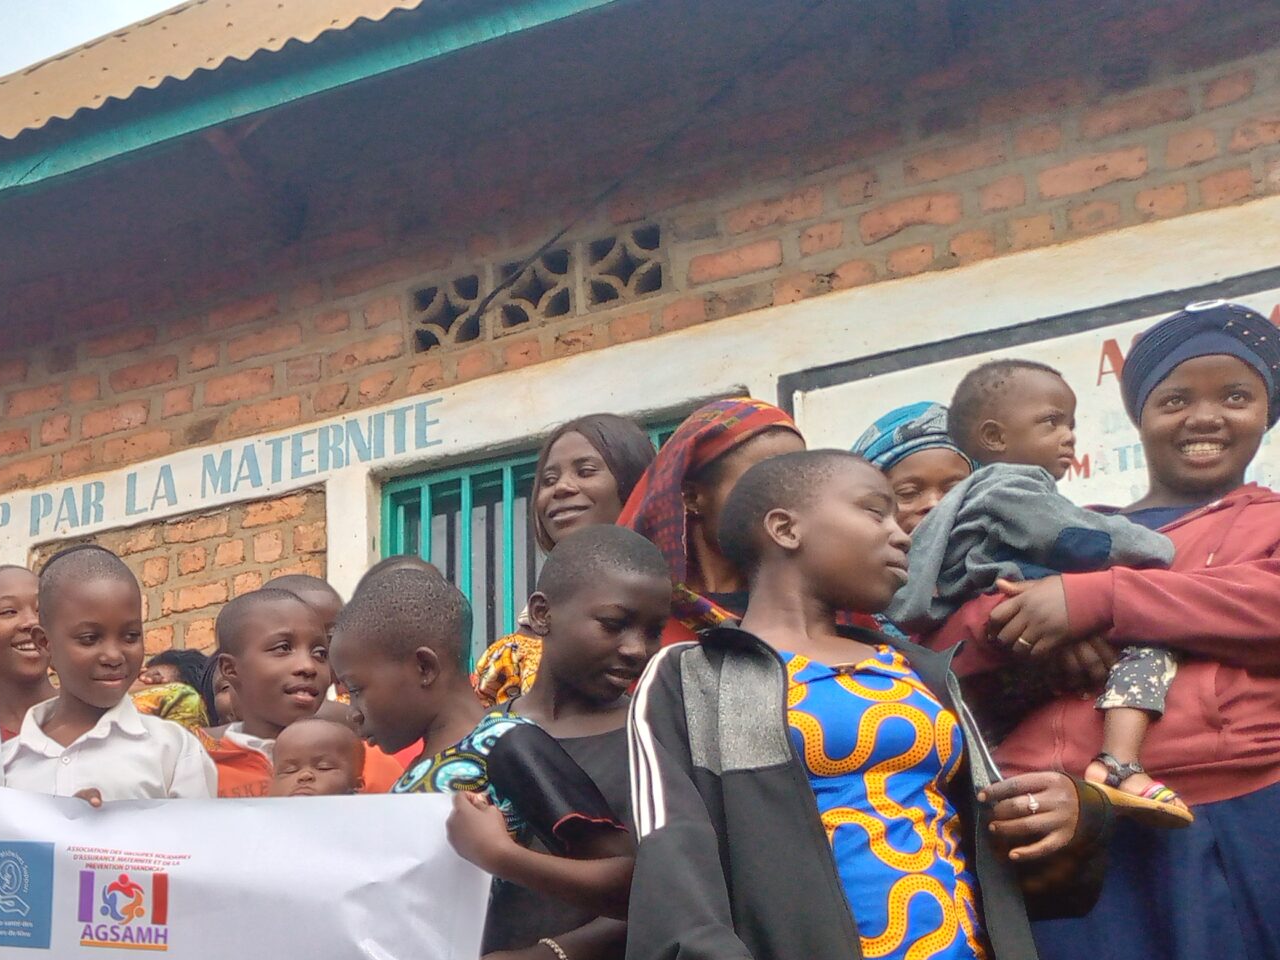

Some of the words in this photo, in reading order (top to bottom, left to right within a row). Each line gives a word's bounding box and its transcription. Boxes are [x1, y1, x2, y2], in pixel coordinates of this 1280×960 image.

[29, 481, 105, 538] PAR
[125, 464, 178, 516] LA
[200, 397, 444, 499] MATERNITE
[81, 924, 168, 944] AGSAMH
